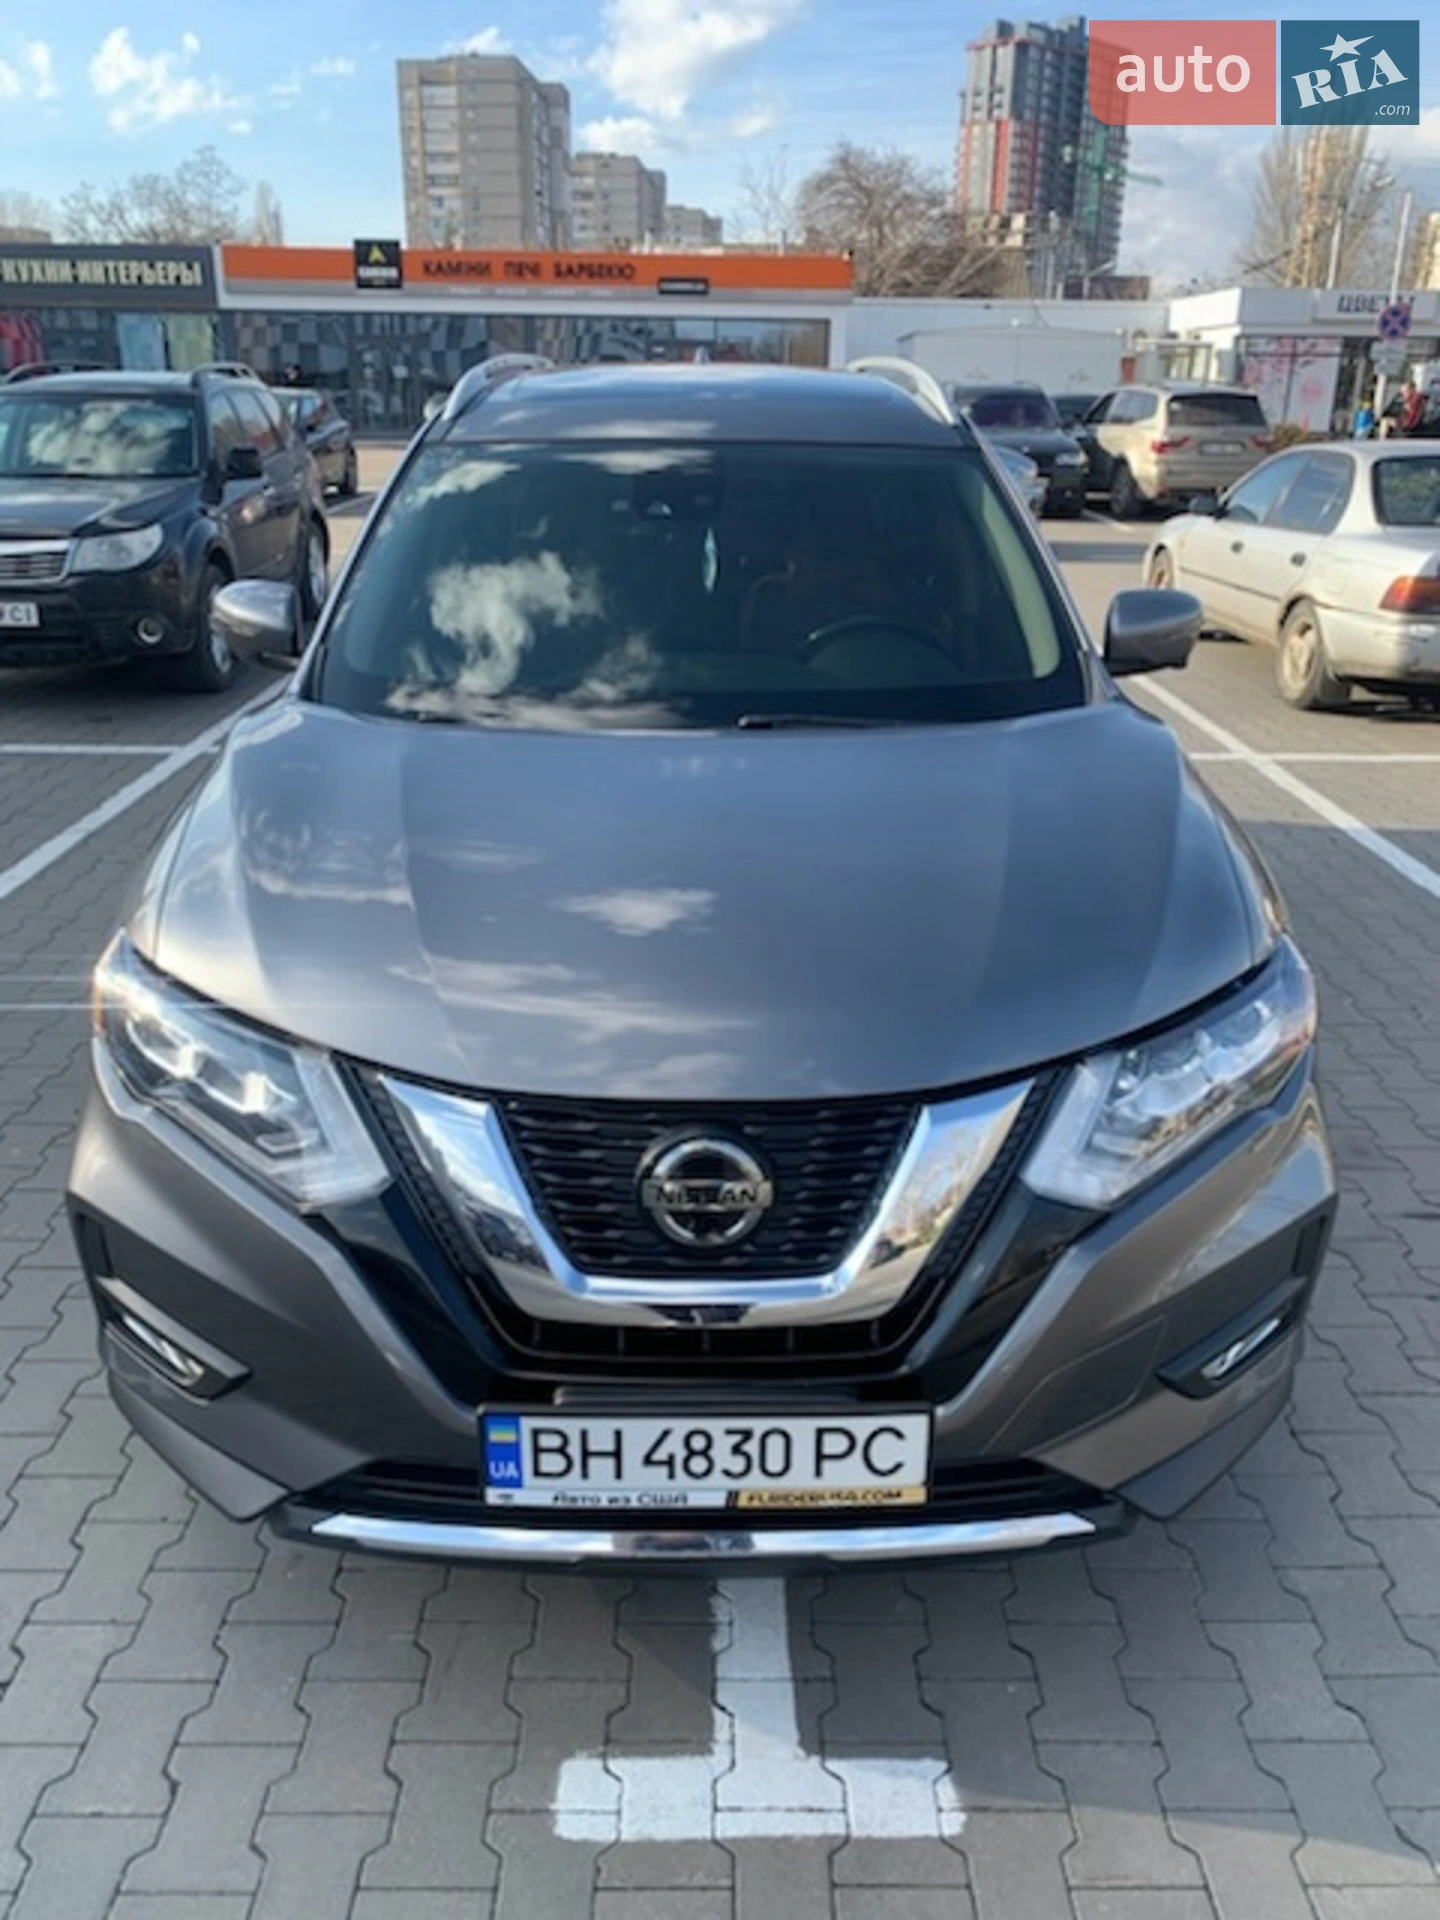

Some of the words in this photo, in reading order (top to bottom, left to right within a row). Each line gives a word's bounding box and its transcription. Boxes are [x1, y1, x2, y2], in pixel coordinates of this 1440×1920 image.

[656, 1185, 757, 1204] NISSAN
[531, 1427, 622, 1480] BH
[642, 1427, 793, 1480] 4830
[815, 1426, 907, 1479] PC
[489, 1461, 519, 1479] UA
[552, 1490, 600, 1506] Авто
